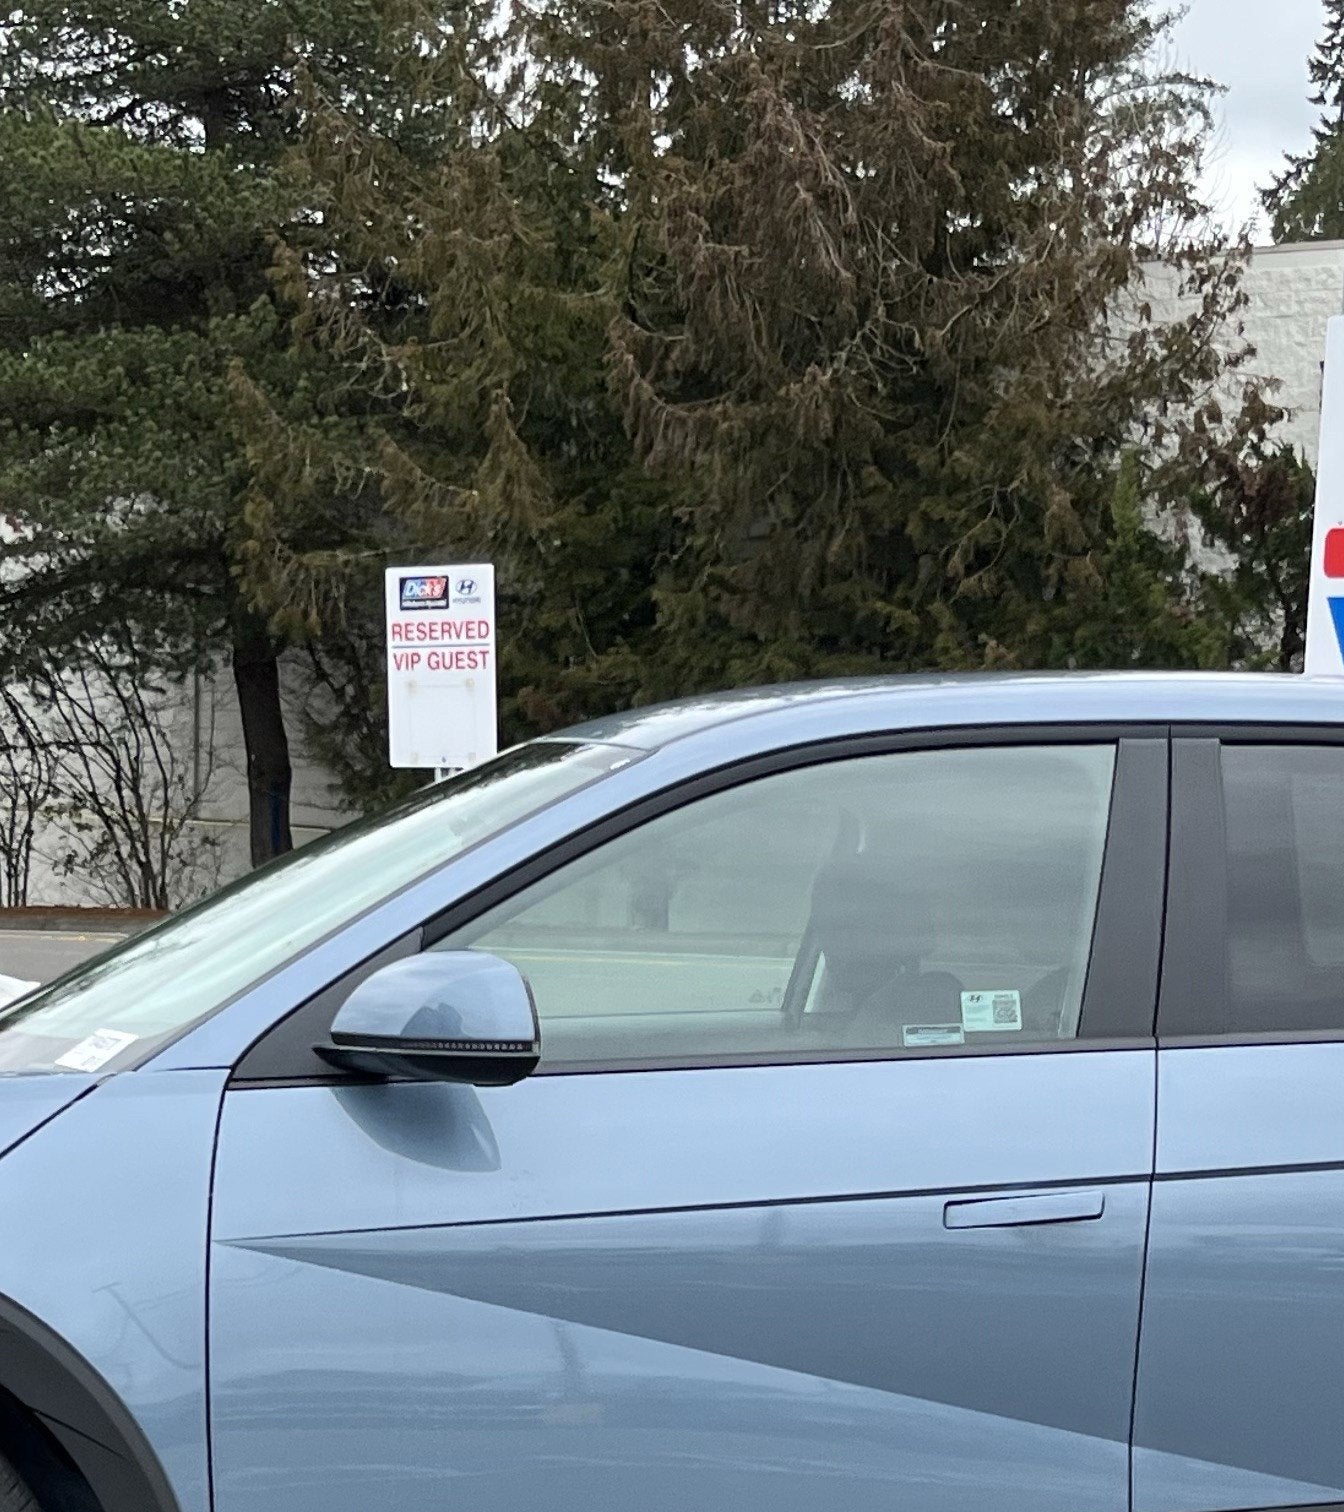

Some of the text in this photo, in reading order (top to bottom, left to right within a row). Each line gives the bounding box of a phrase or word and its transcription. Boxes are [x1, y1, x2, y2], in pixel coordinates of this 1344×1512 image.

[391, 620, 490, 642] RESERVED
[393, 650, 490, 671] VIP GUEST
